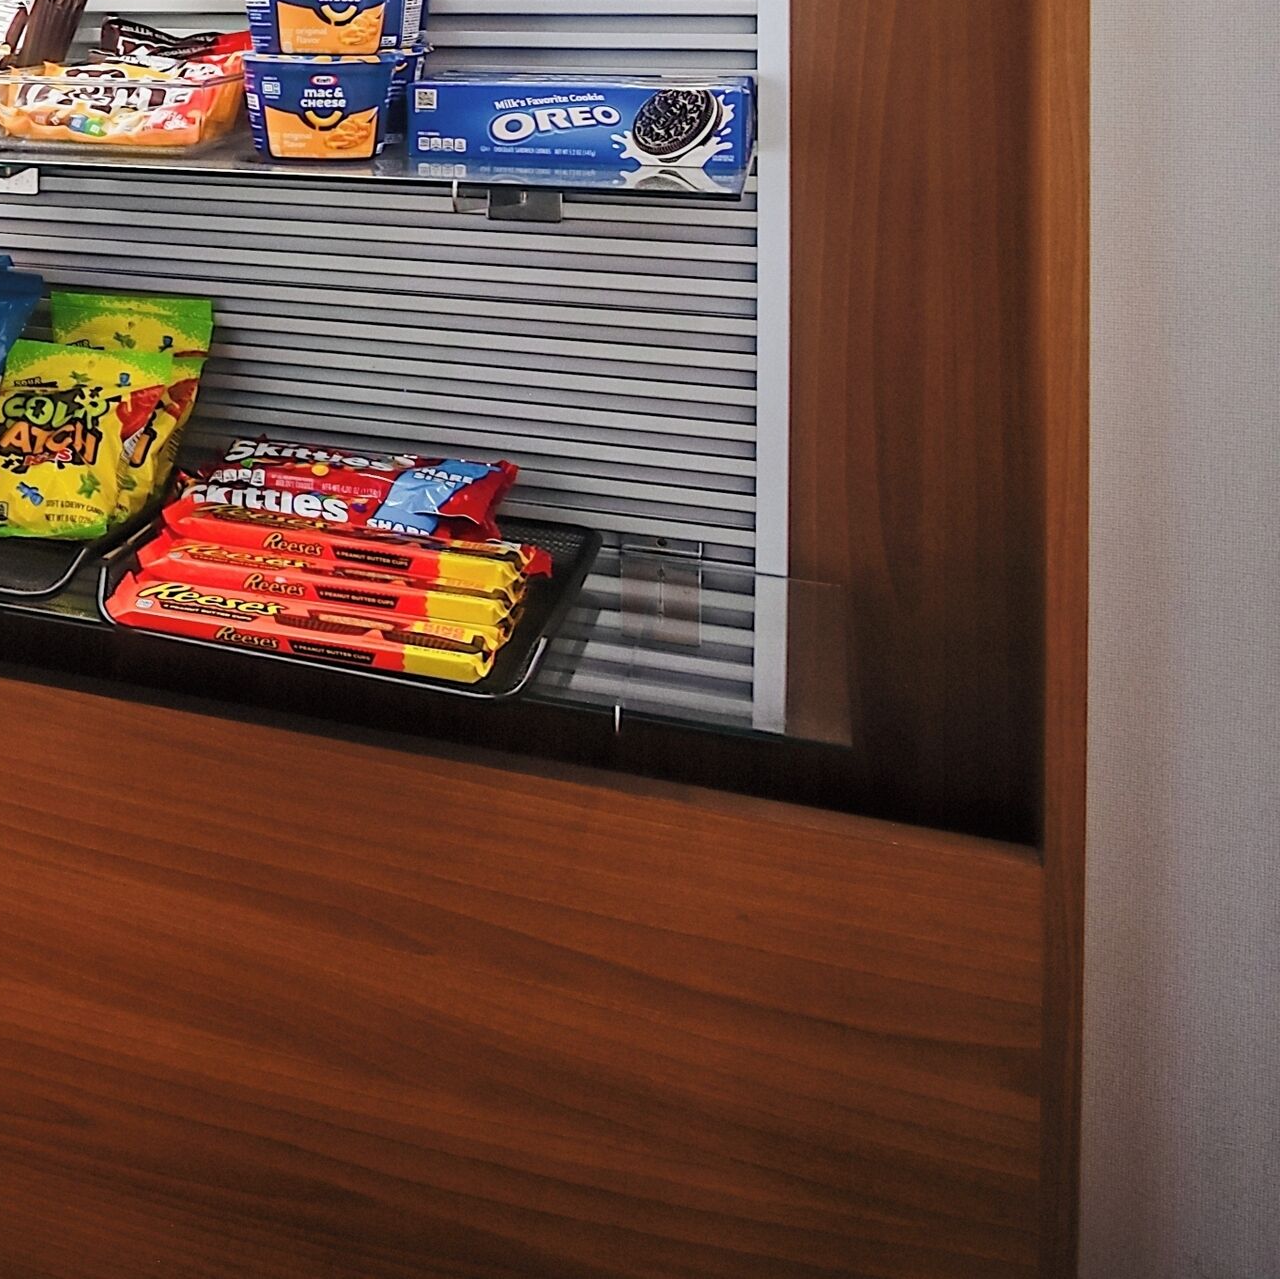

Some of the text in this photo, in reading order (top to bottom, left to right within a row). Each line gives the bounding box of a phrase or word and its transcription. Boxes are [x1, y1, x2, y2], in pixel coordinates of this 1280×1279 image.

[304, 87, 344, 98] mac &
[494, 93, 605, 111] Milk's Favorite Cookie
[491, 105, 621, 141] OREO
[0, 422, 97, 465] ATCH
[262, 532, 323, 557] Reese's
[340, 551, 409, 567] PEANUT BUTTER CUPS
[243, 573, 305, 597] Reese's
[139, 583, 289, 617] Reese's
[324, 590, 395, 606] PEANUT BUTTER CUPS
[170, 605, 197, 615] PEANUT
[199, 608, 228, 618] BUTTER
[215, 625, 279, 650] Reese's
[298, 645, 371, 662] PEANUT BUTTER CUPS
